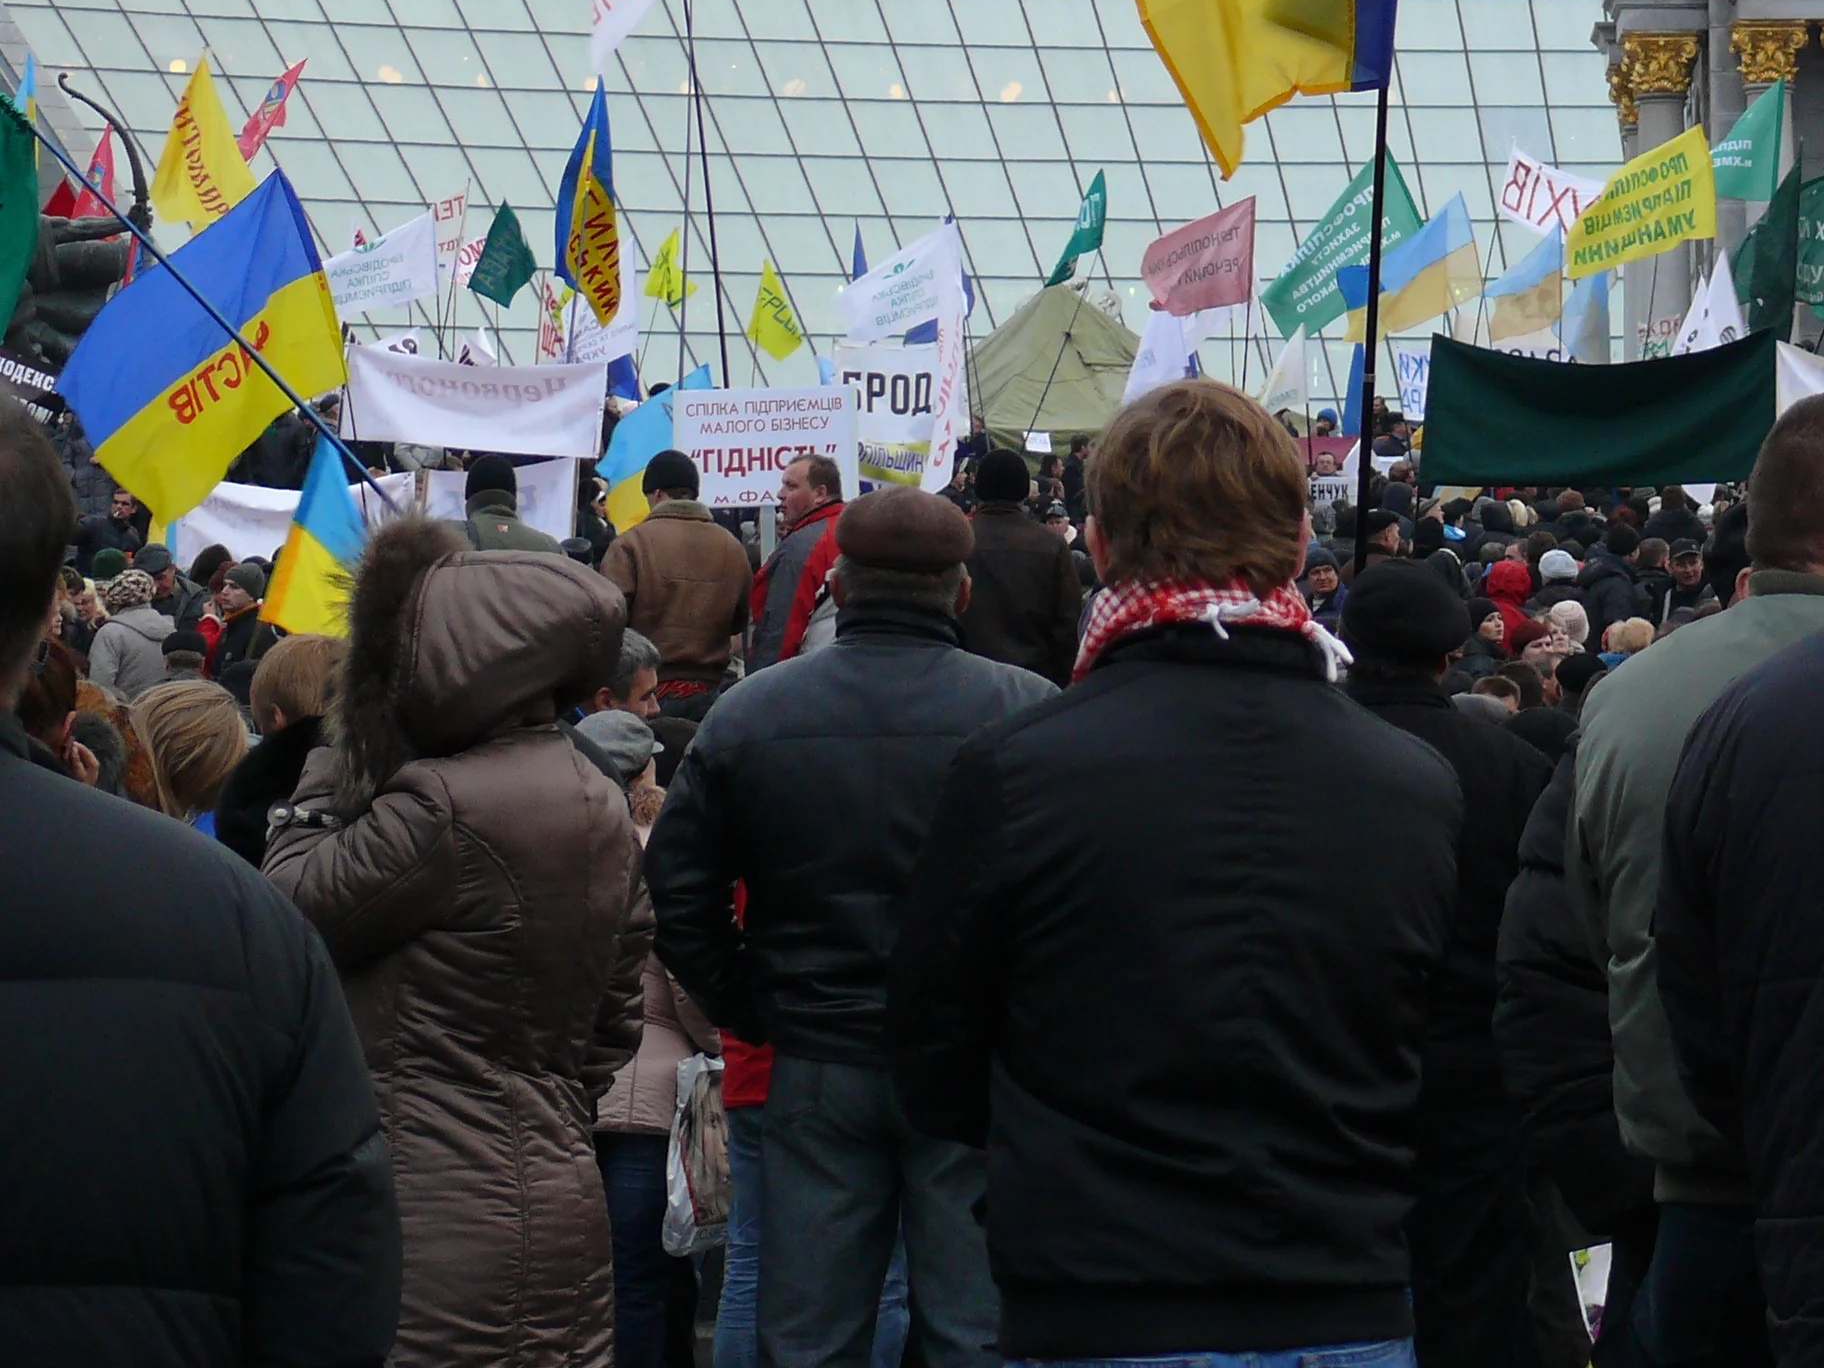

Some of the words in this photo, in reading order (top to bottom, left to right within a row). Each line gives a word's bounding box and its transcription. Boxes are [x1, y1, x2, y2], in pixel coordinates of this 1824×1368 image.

[685, 401, 739, 417] СПІЛКА
[744, 396, 843, 416] ПІДПРИЄМЦІВ
[699, 419, 765, 435] МАЛОГО
[771, 416, 830, 432] БІЗНЕСУ
